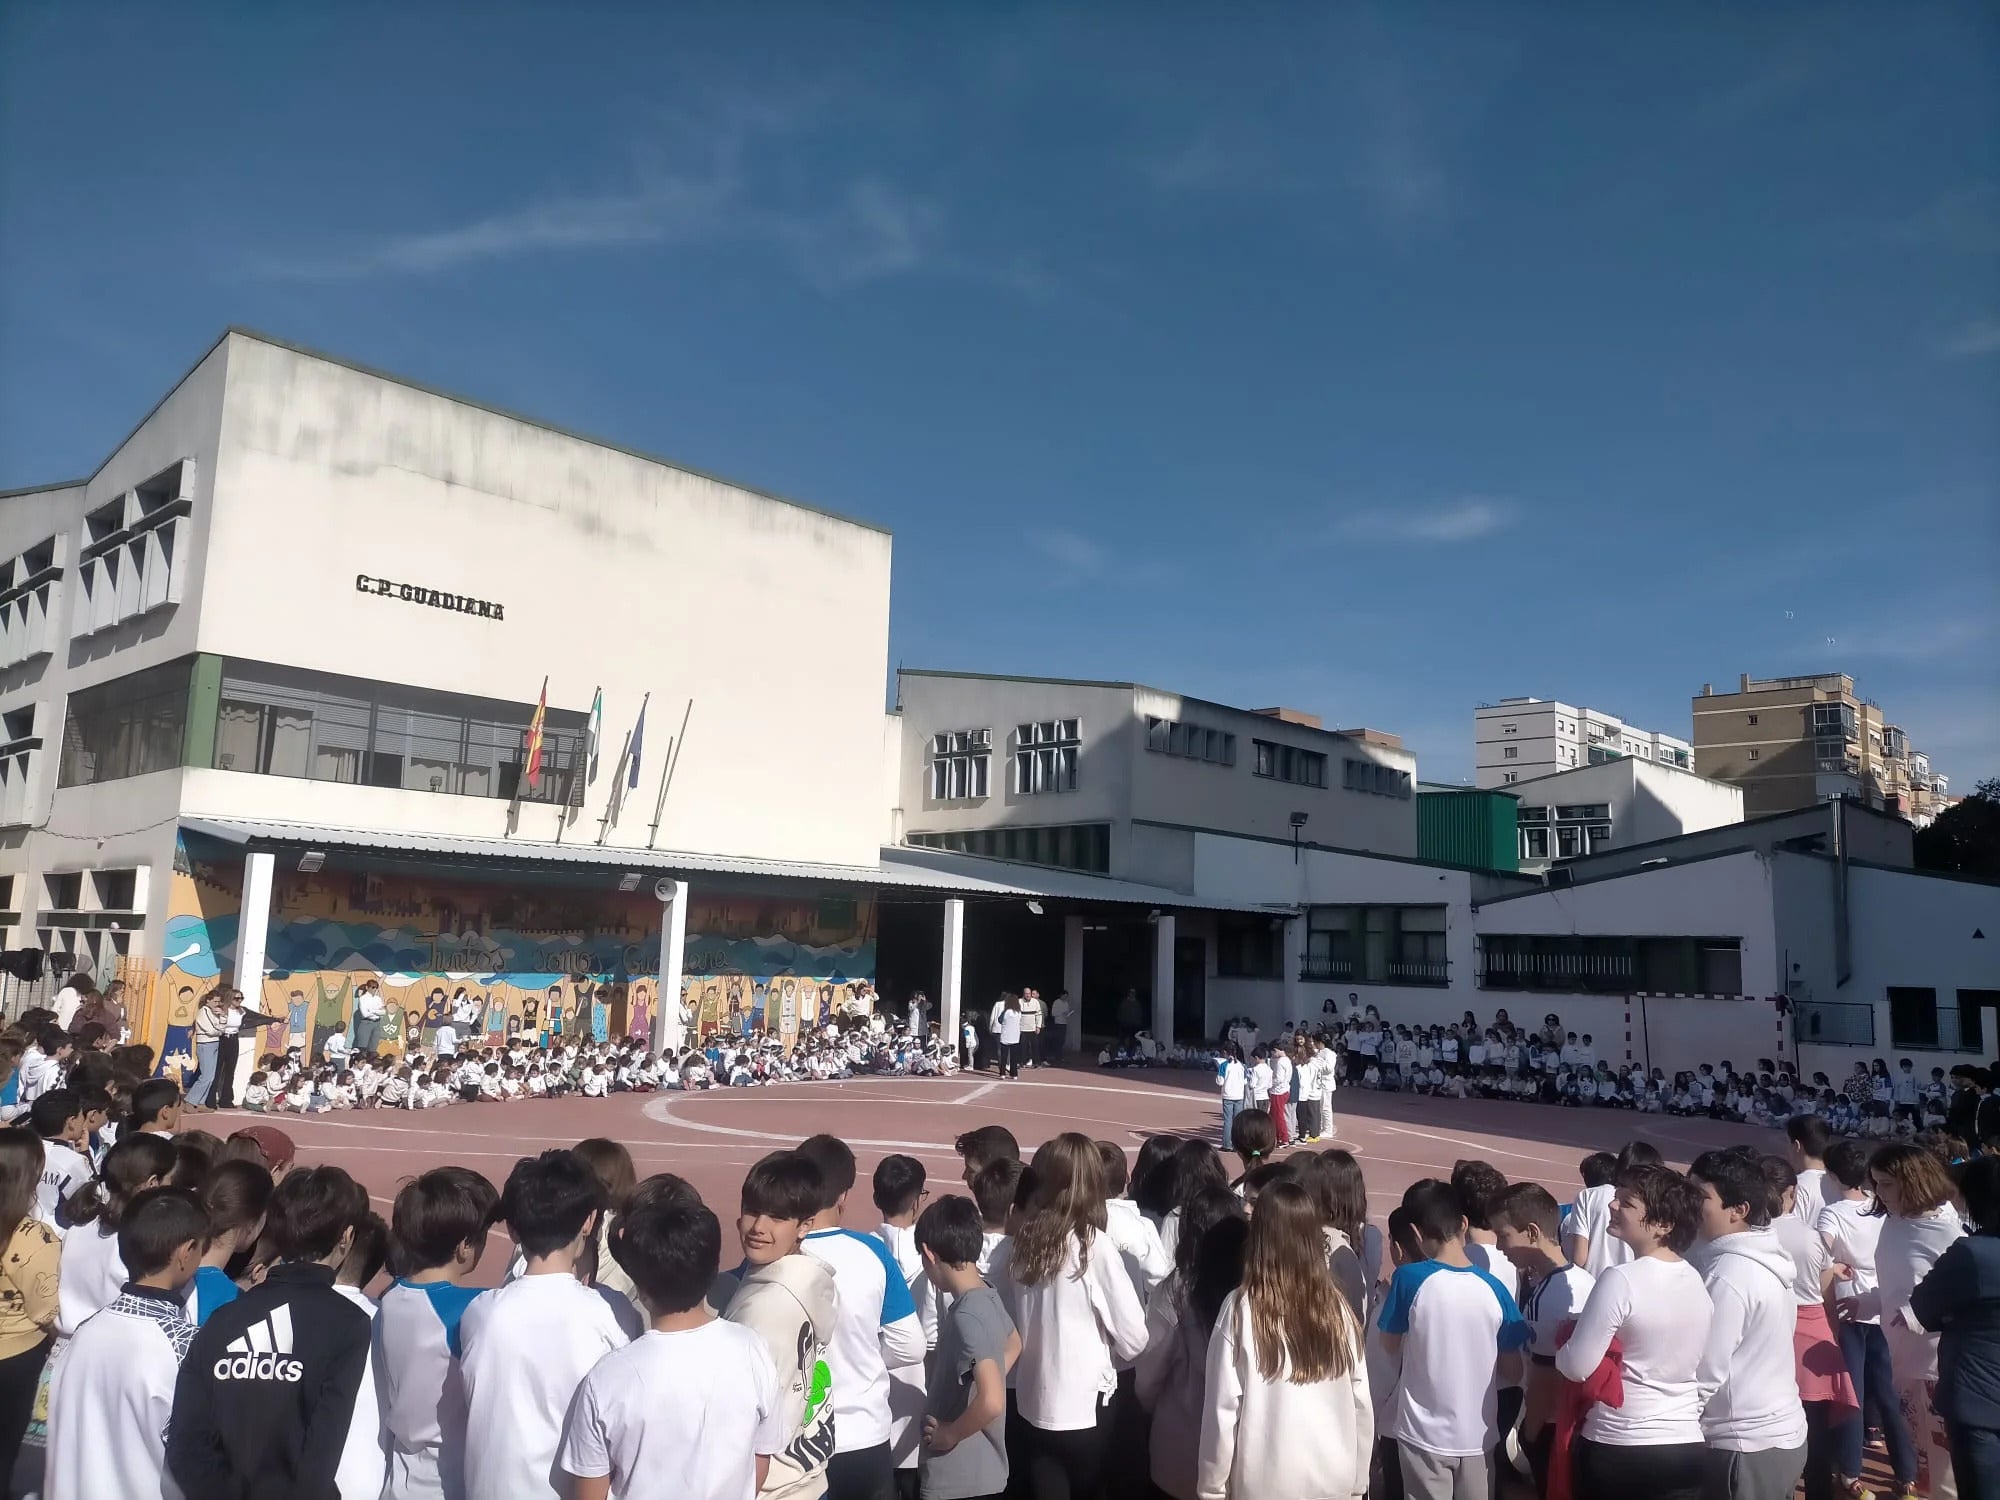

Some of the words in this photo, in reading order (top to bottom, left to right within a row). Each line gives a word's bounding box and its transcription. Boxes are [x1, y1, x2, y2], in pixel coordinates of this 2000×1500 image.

[356, 574, 394, 597] C.P.
[400, 583, 504, 621] GUADIANA
[411, 934, 505, 973] Juntos
[623, 944, 729, 975] Guaana
